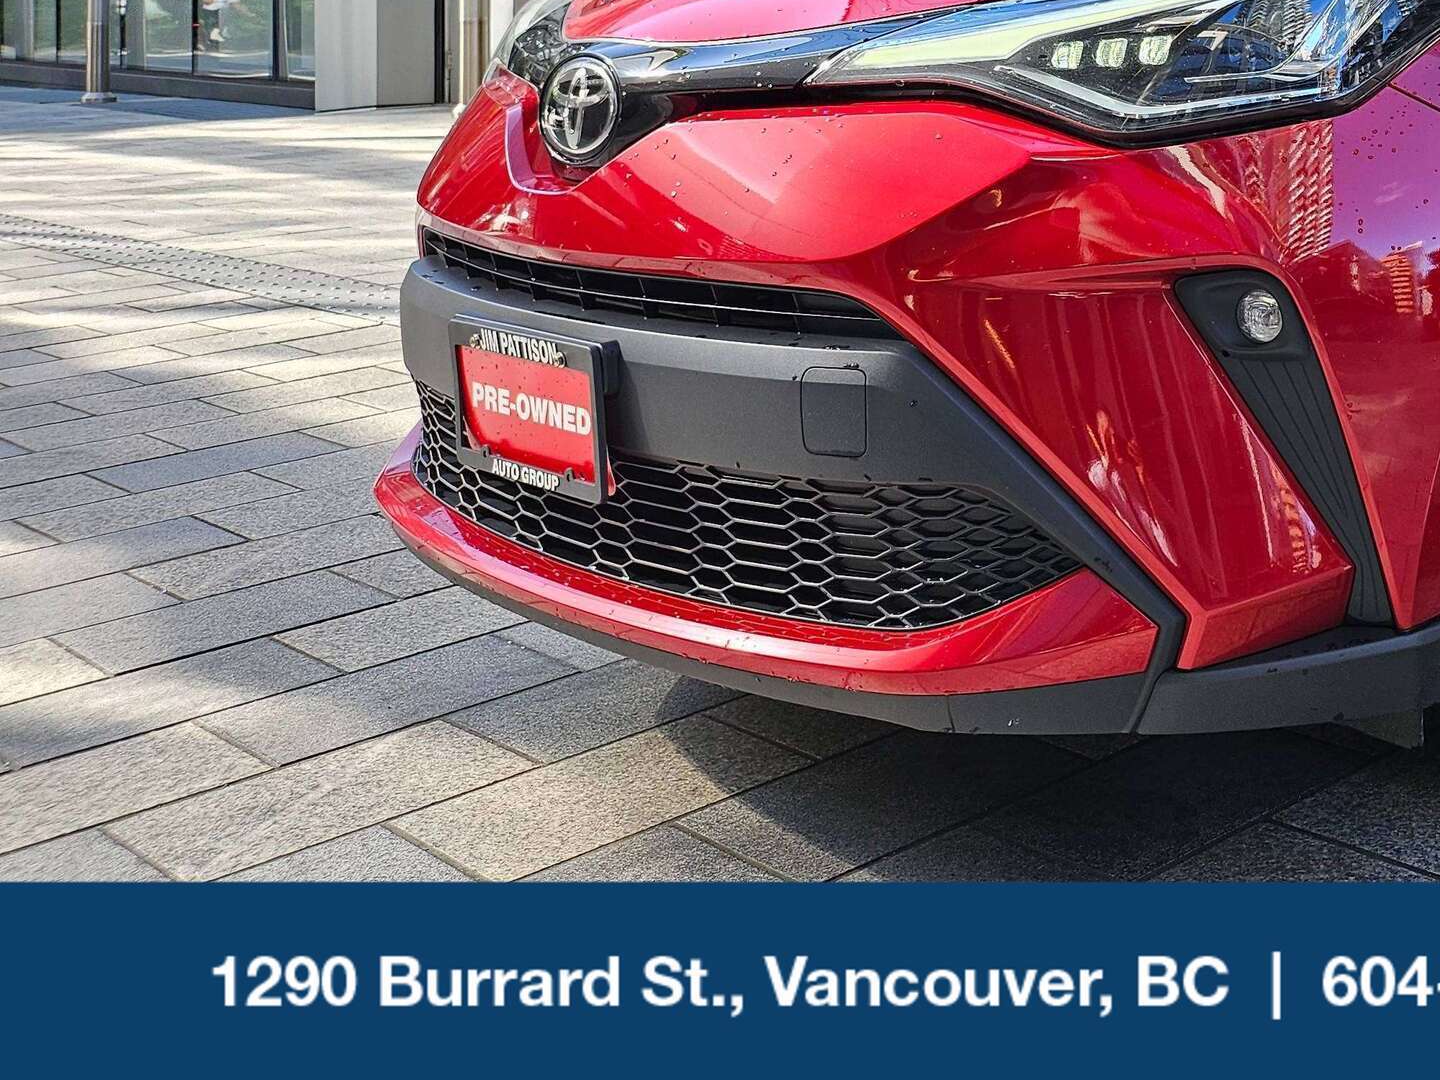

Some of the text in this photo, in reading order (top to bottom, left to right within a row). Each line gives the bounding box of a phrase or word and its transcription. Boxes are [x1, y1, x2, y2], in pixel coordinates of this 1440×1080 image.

[479, 327, 560, 366] JIM PATTISON
[471, 382, 592, 436] PRE-OWNED
[492, 458, 560, 491] AUTO GROUP
